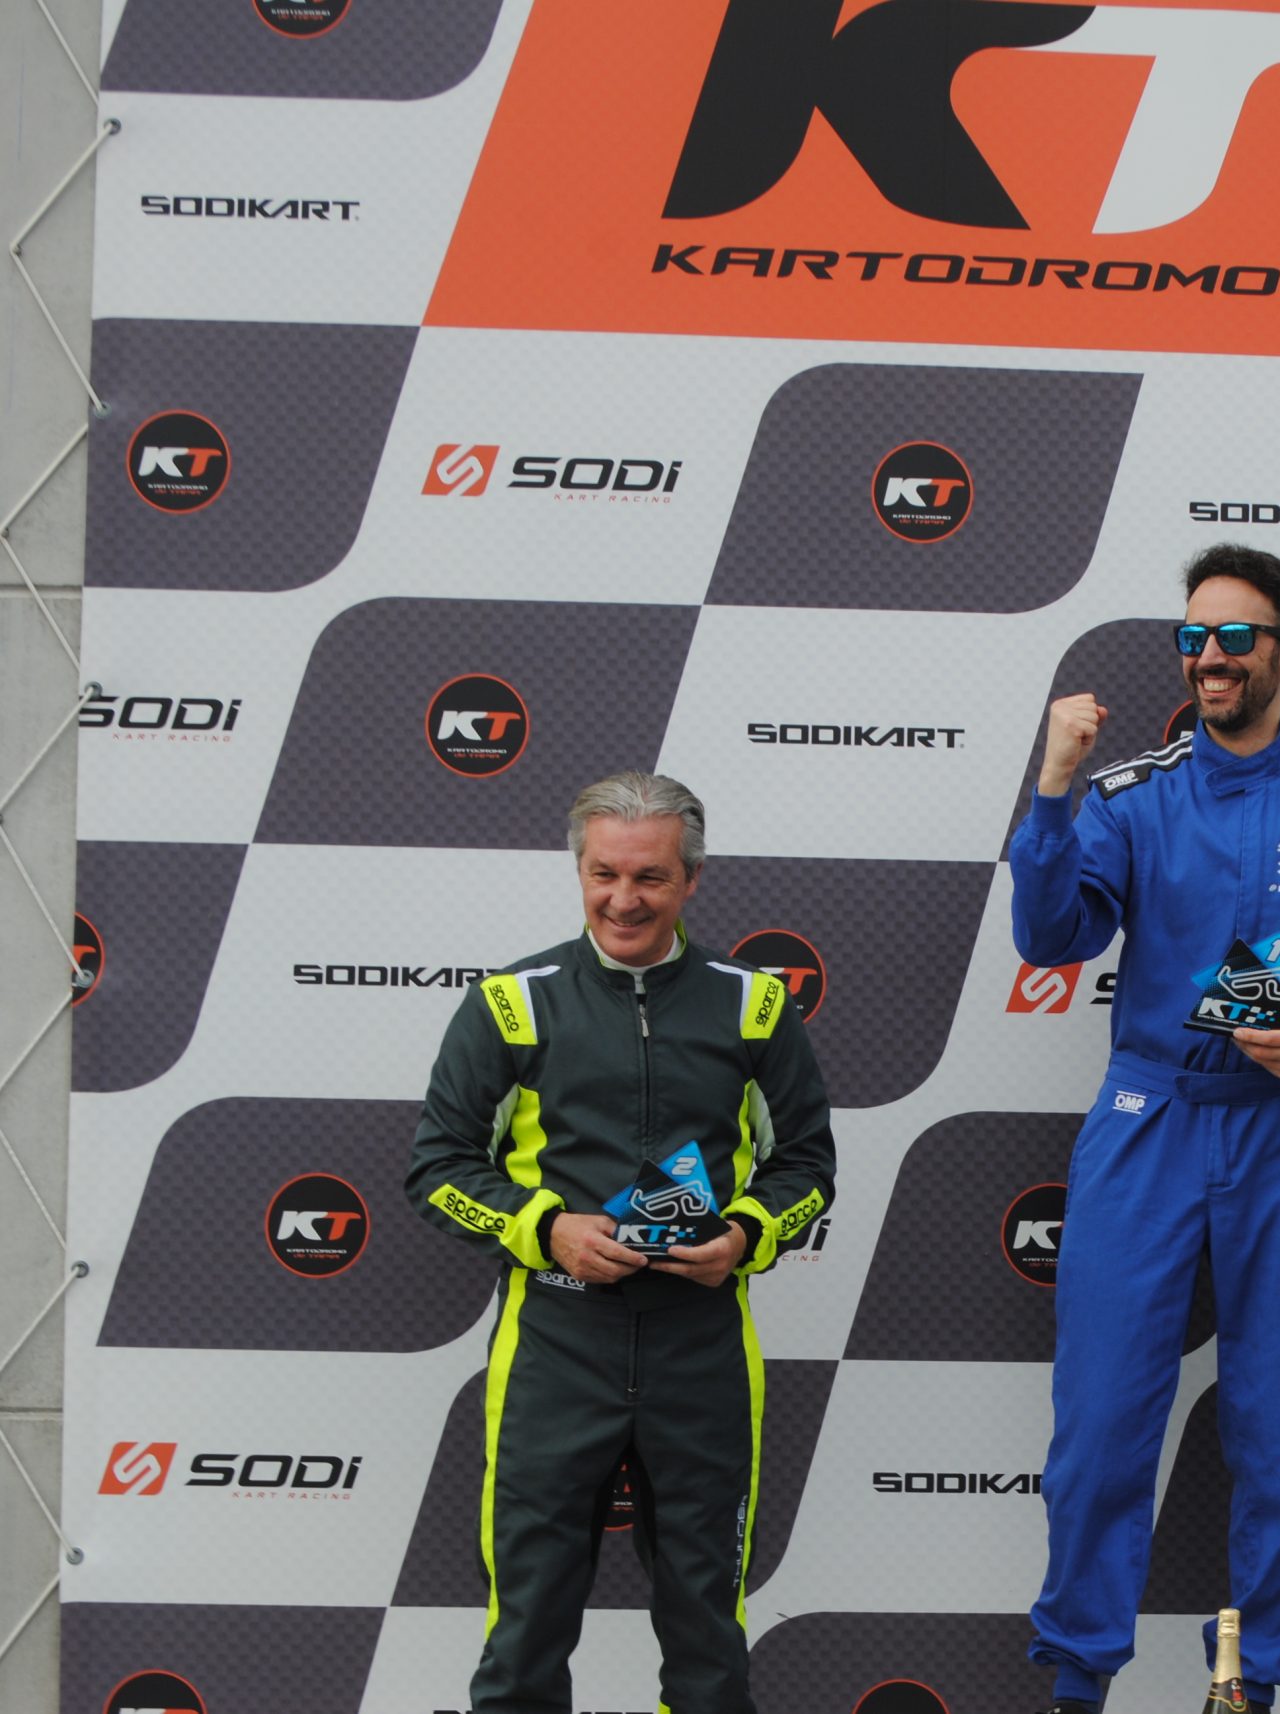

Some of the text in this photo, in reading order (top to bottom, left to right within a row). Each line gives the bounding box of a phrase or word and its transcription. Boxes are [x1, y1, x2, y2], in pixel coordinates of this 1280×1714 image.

[141, 196, 359, 220] SODIKART
[652, 244, 1280, 296] KARTODROMO
[138, 447, 223, 478] KT
[883, 477, 965, 507] KT
[437, 710, 521, 741] KT
[748, 723, 965, 748] SODIKART
[1103, 770, 1137, 790] OMP
[491, 983, 520, 1033] sparco
[755, 981, 778, 1026] sparco
[1197, 996, 1250, 1020] KT
[1114, 1093, 1146, 1112] OMP
[671, 1156, 698, 1176] 2
[277, 1210, 361, 1241] KT
[444, 1192, 506, 1233] sparco
[616, 1224, 670, 1244] KT
